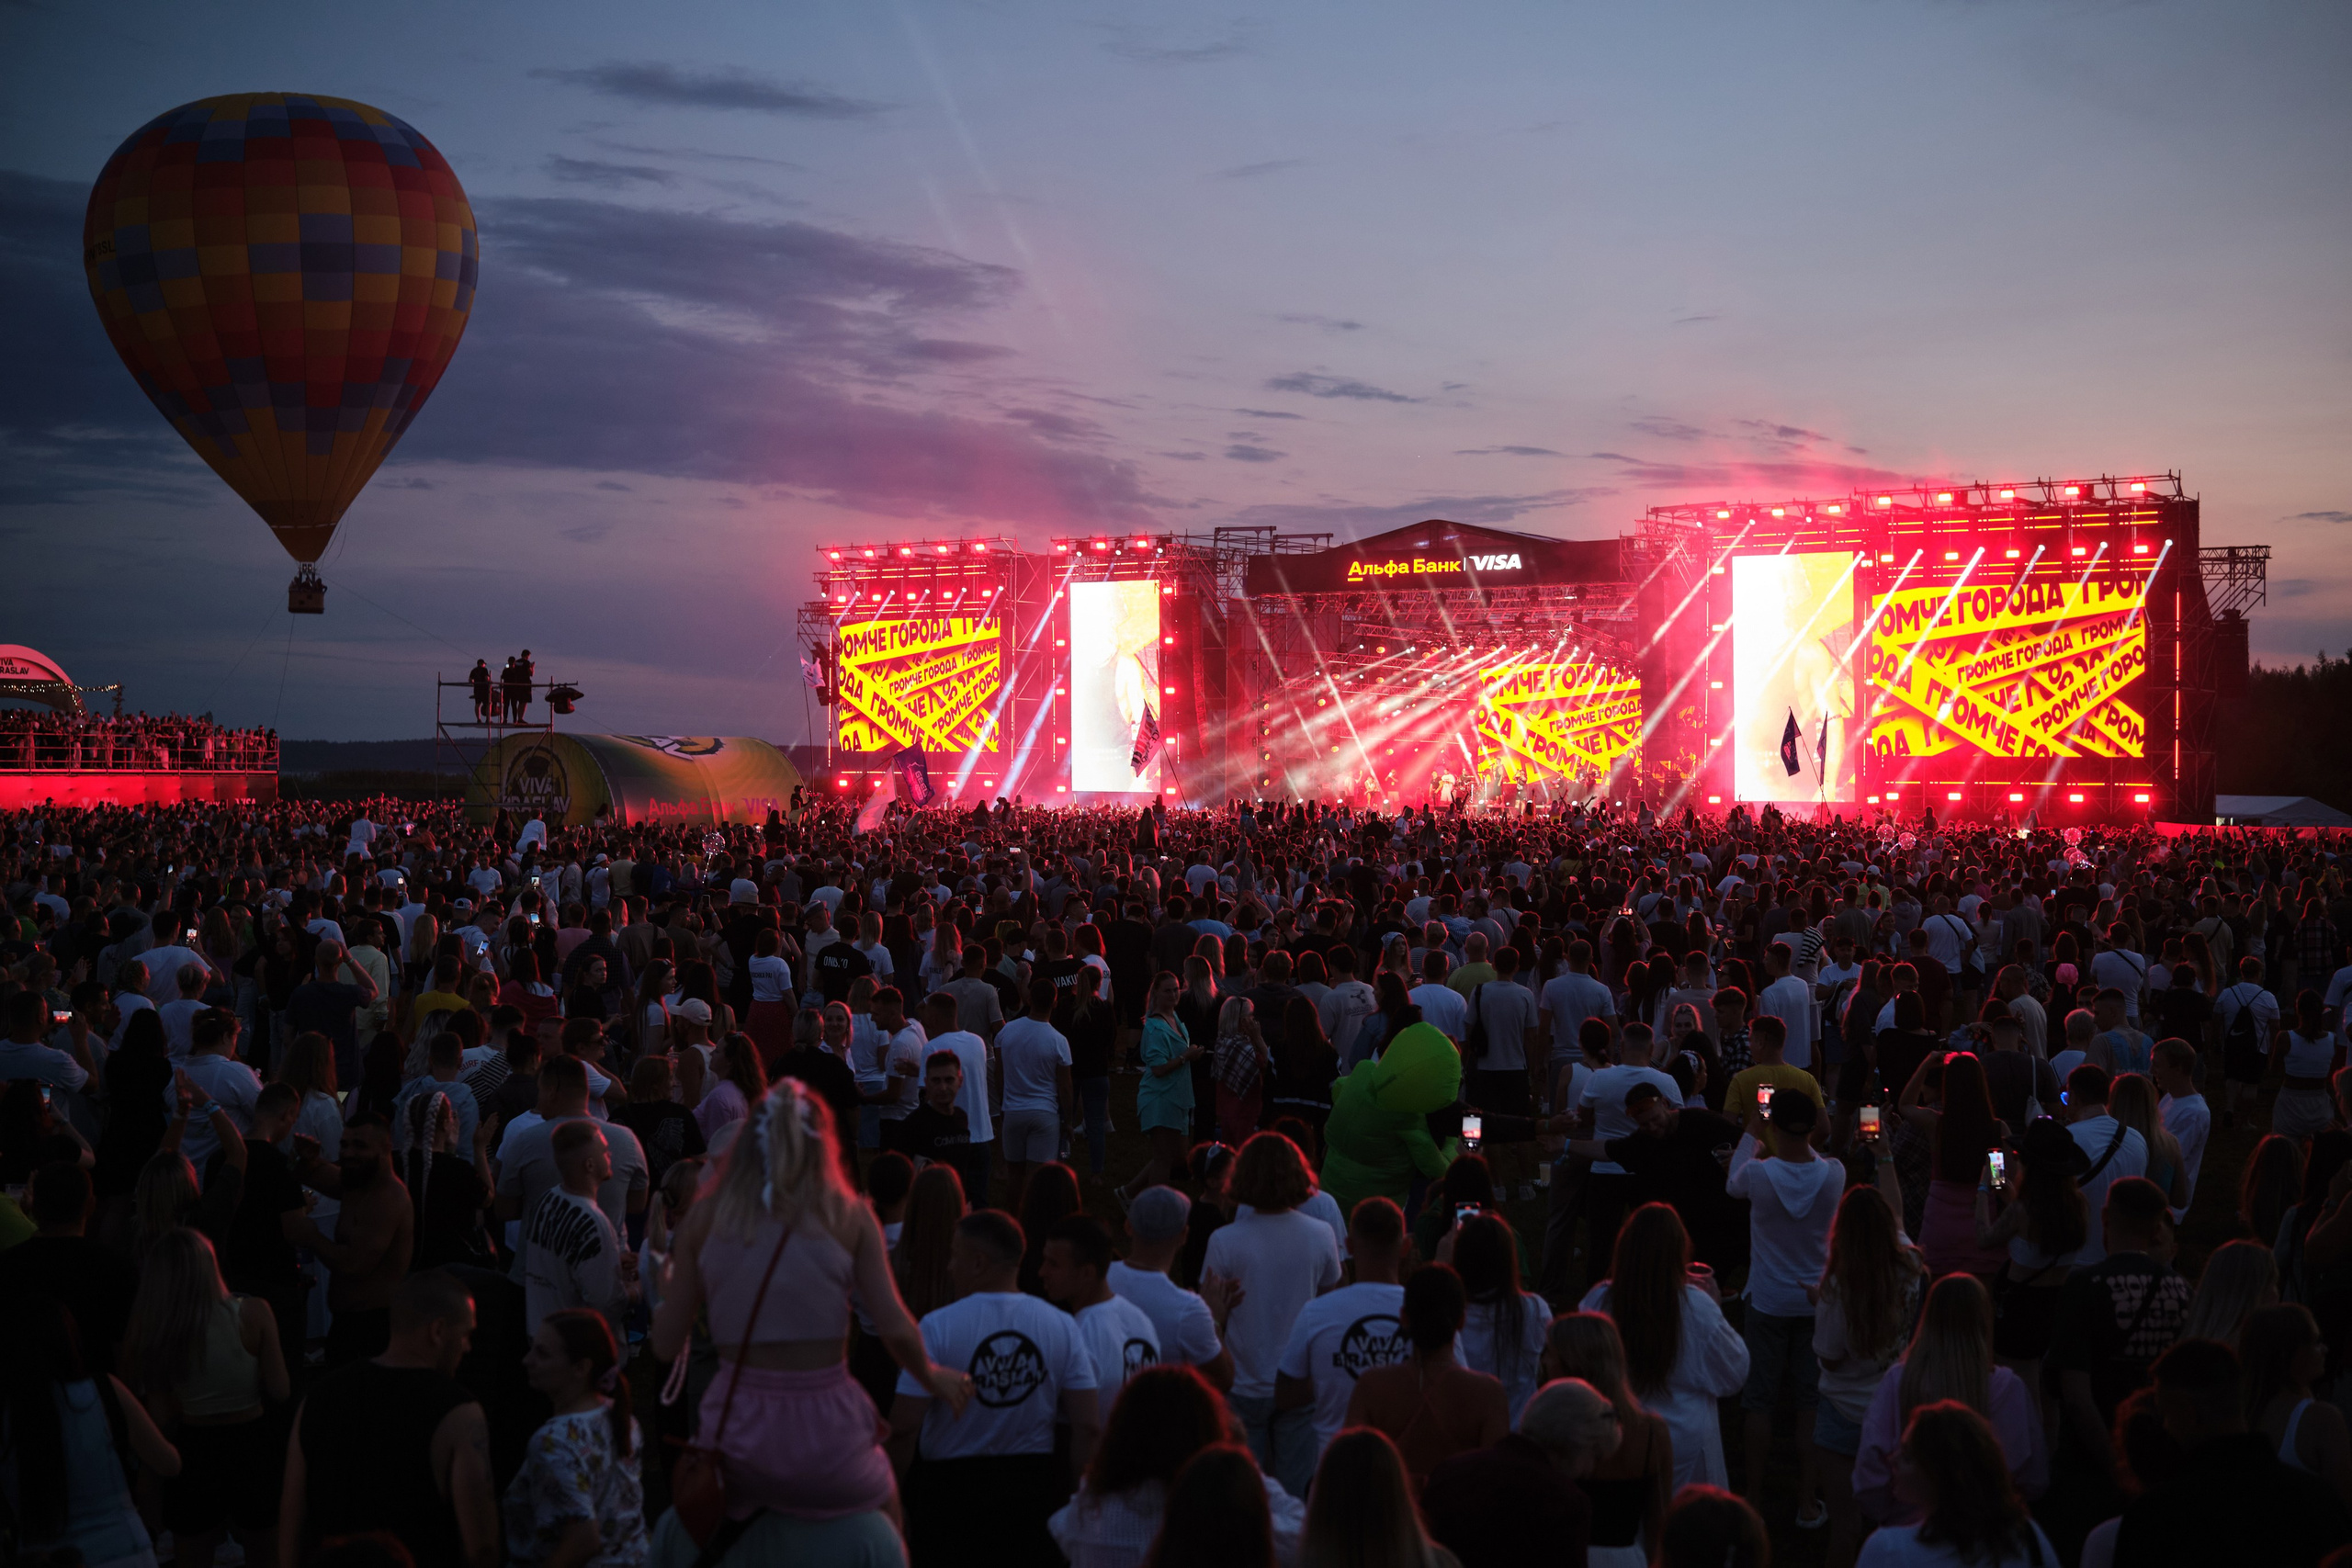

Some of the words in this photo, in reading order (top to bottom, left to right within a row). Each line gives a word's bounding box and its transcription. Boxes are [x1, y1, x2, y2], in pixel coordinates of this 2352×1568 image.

[1348, 559, 1409, 579] Альфа
[1413, 558, 1462, 573] Банк
[1469, 554, 1522, 570] VISA
[1872, 594, 1952, 637] ОМЧЕ
[1958, 582, 2065, 625] ГОРОДА
[839, 626, 887, 660] ОМЧЕ
[889, 618, 953, 649] ГОРОДА
[1958, 652, 2015, 683] ГРОМЧЕ
[2016, 633, 2074, 666] ГОРОДА
[2081, 614, 2141, 645] ГРОМЧЕ
[889, 671, 922, 695] ГРОМЧЕ
[923, 657, 957, 681] ГОРОДА
[962, 642, 998, 666] ГРОМЧЕ
[1478, 670, 1545, 699] ОМЧЕ
[1549, 710, 1596, 733] ГРОМЧЕ
[649, 797, 699, 819] Альфа
[700, 797, 738, 815] Банк
[458, 1059, 479, 1073] SURF
[1357, 1336, 1405, 1352] VIVA
[1332, 1352, 1409, 1368] BRASL
